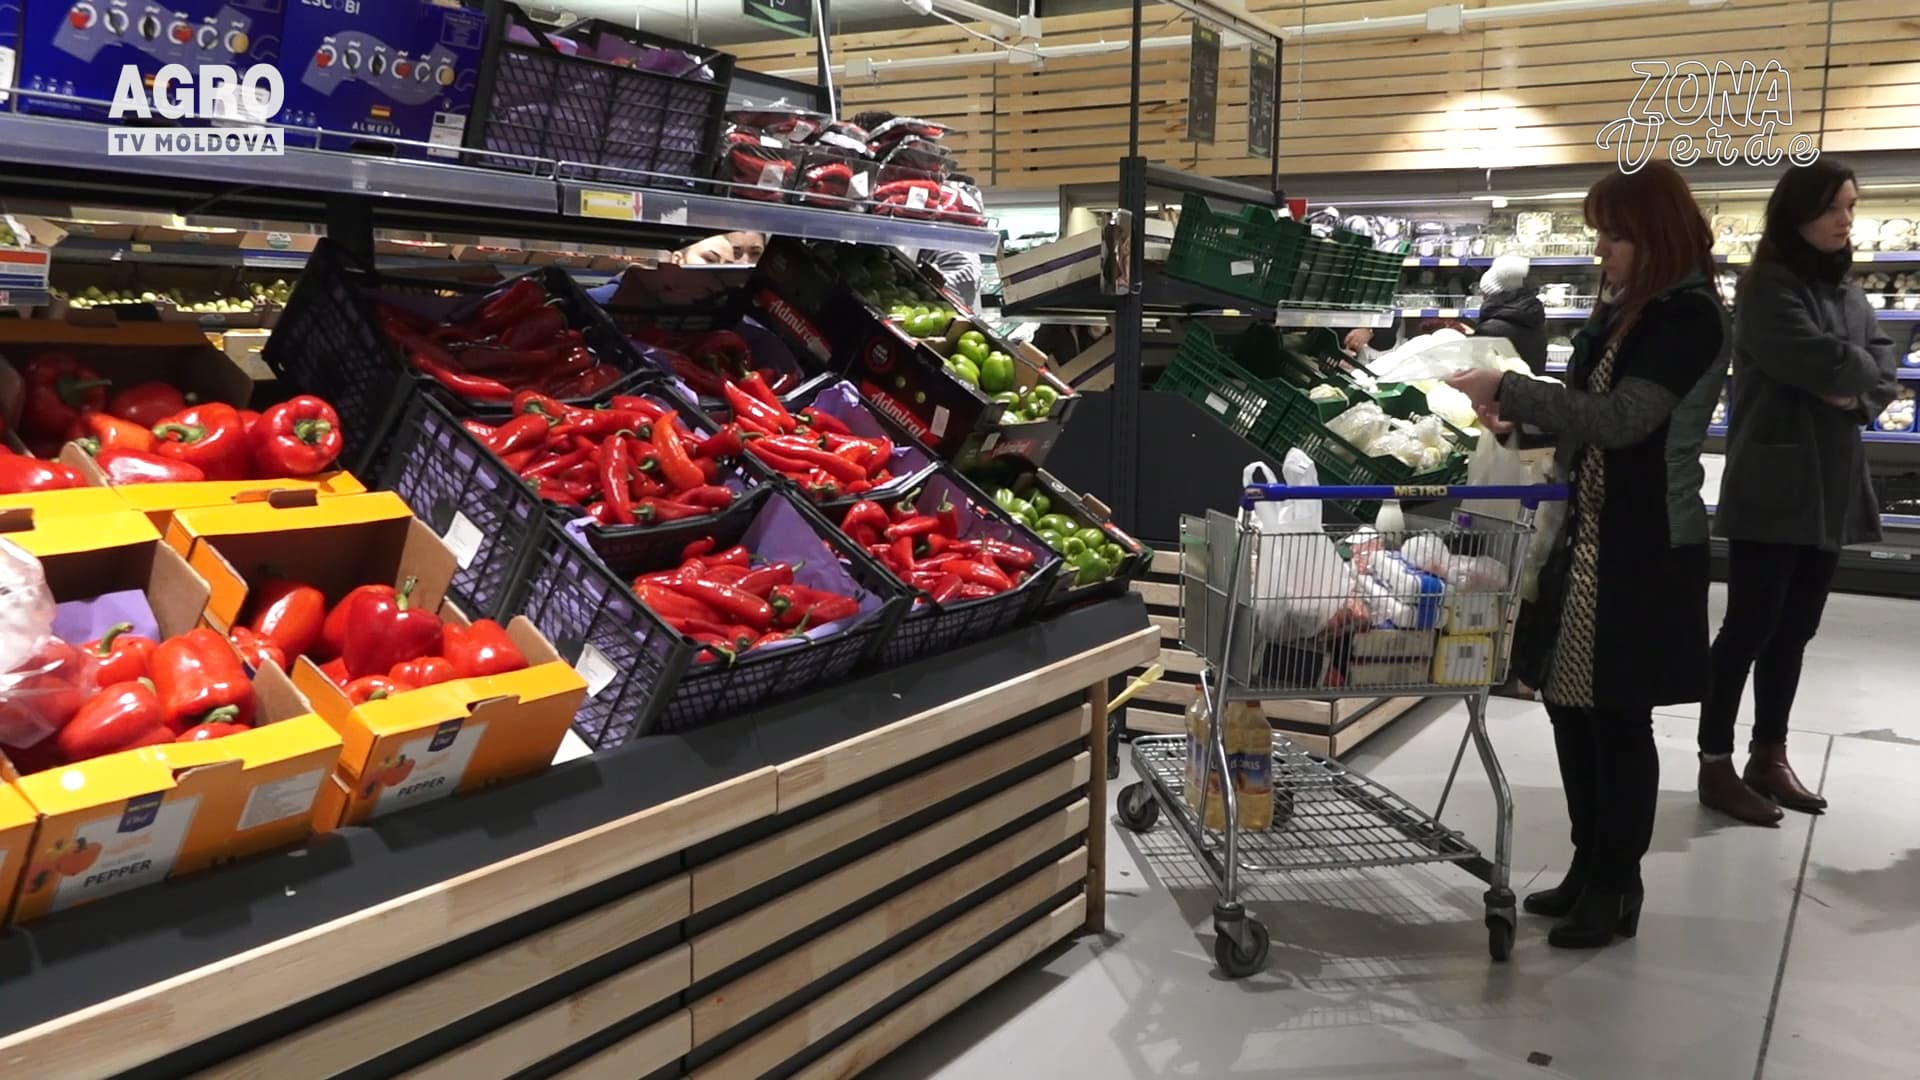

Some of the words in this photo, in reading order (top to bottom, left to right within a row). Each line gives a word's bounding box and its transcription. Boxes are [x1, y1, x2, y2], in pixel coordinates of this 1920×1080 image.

[767, 299, 820, 346] Admira
[870, 391, 927, 439] Admiral
[1393, 485, 1448, 497] METRO
[397, 776, 446, 797] PEPPER
[83, 859, 152, 888] PEPPER
